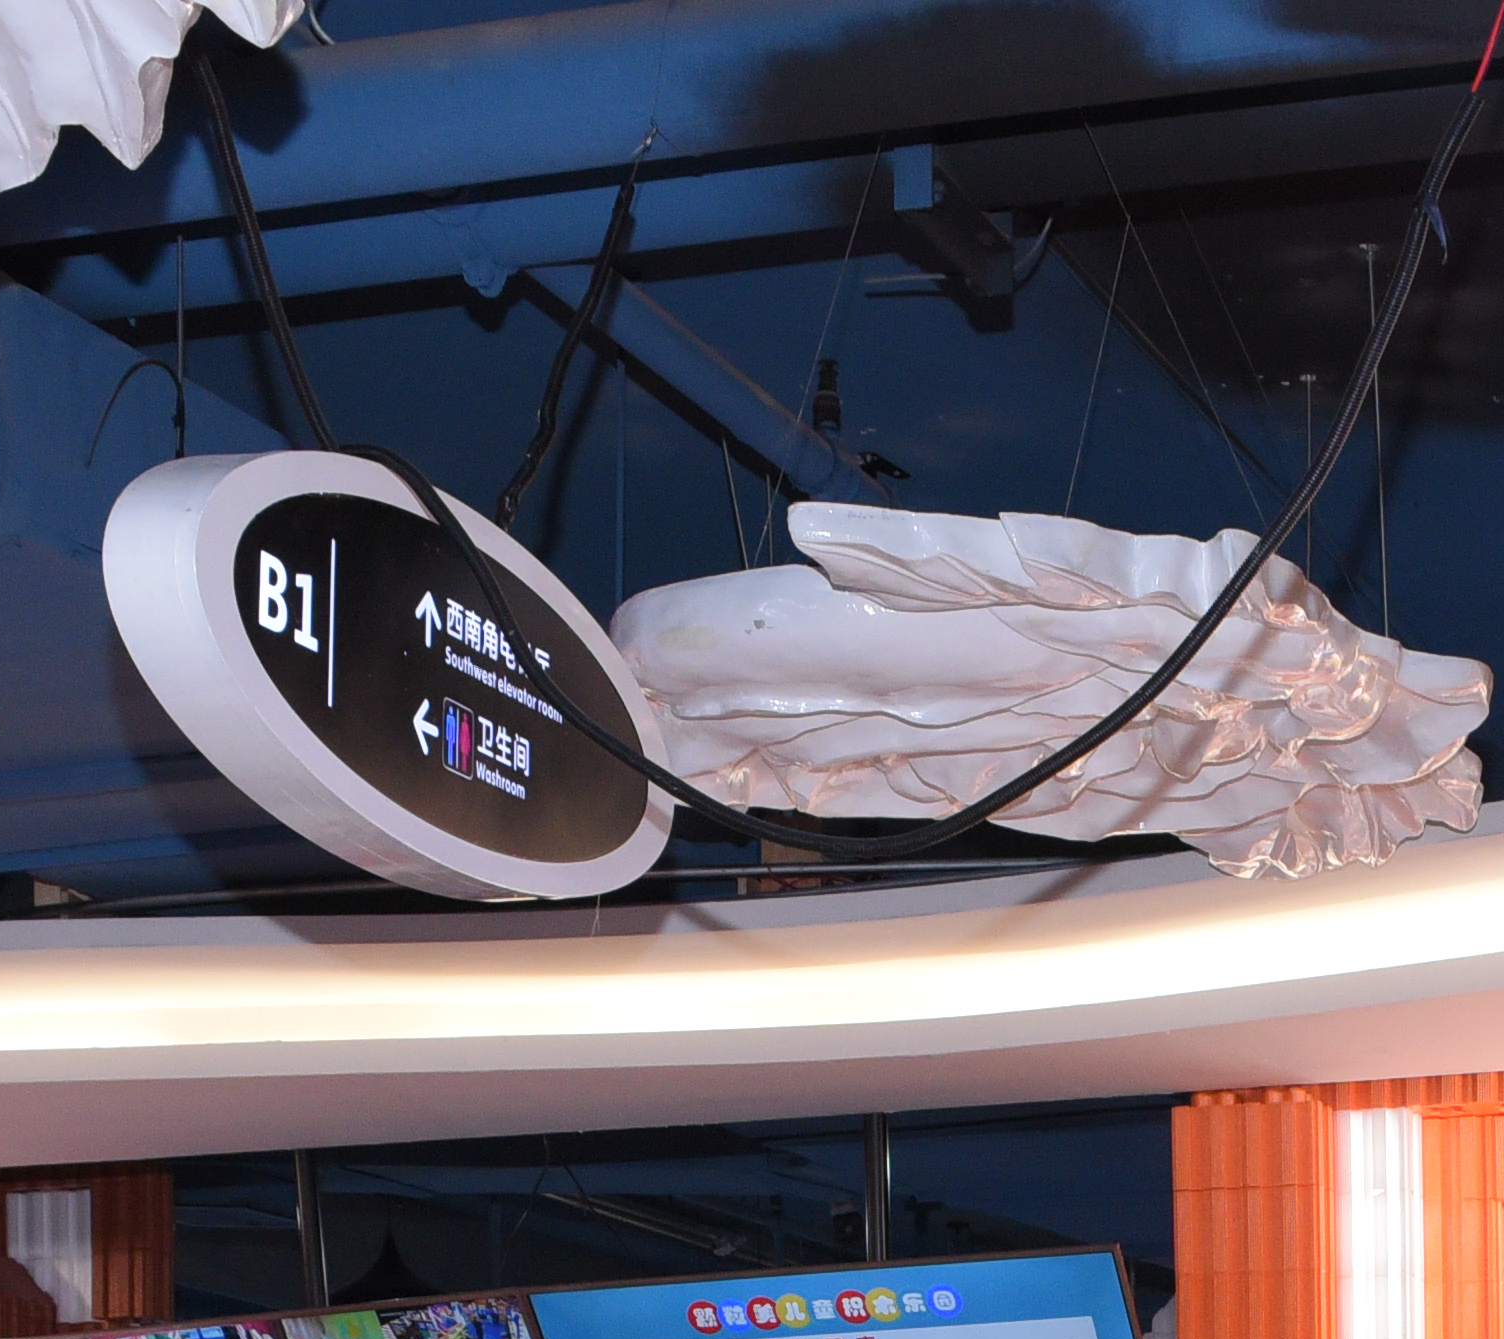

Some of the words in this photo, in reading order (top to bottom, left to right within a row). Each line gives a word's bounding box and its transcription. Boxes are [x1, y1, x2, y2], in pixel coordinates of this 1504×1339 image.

[259, 550, 318, 653] B1
[446, 598, 551, 679] 西南角电厅
[445, 645, 497, 690] Southwest
[497, 675, 537, 709] elevator
[537, 700, 563, 725] room
[476, 760, 526, 800] Washroom
[477, 716, 530, 777] 卫生间
[693, 1290, 956, 1328] 颗粒美儿童积木乐园
